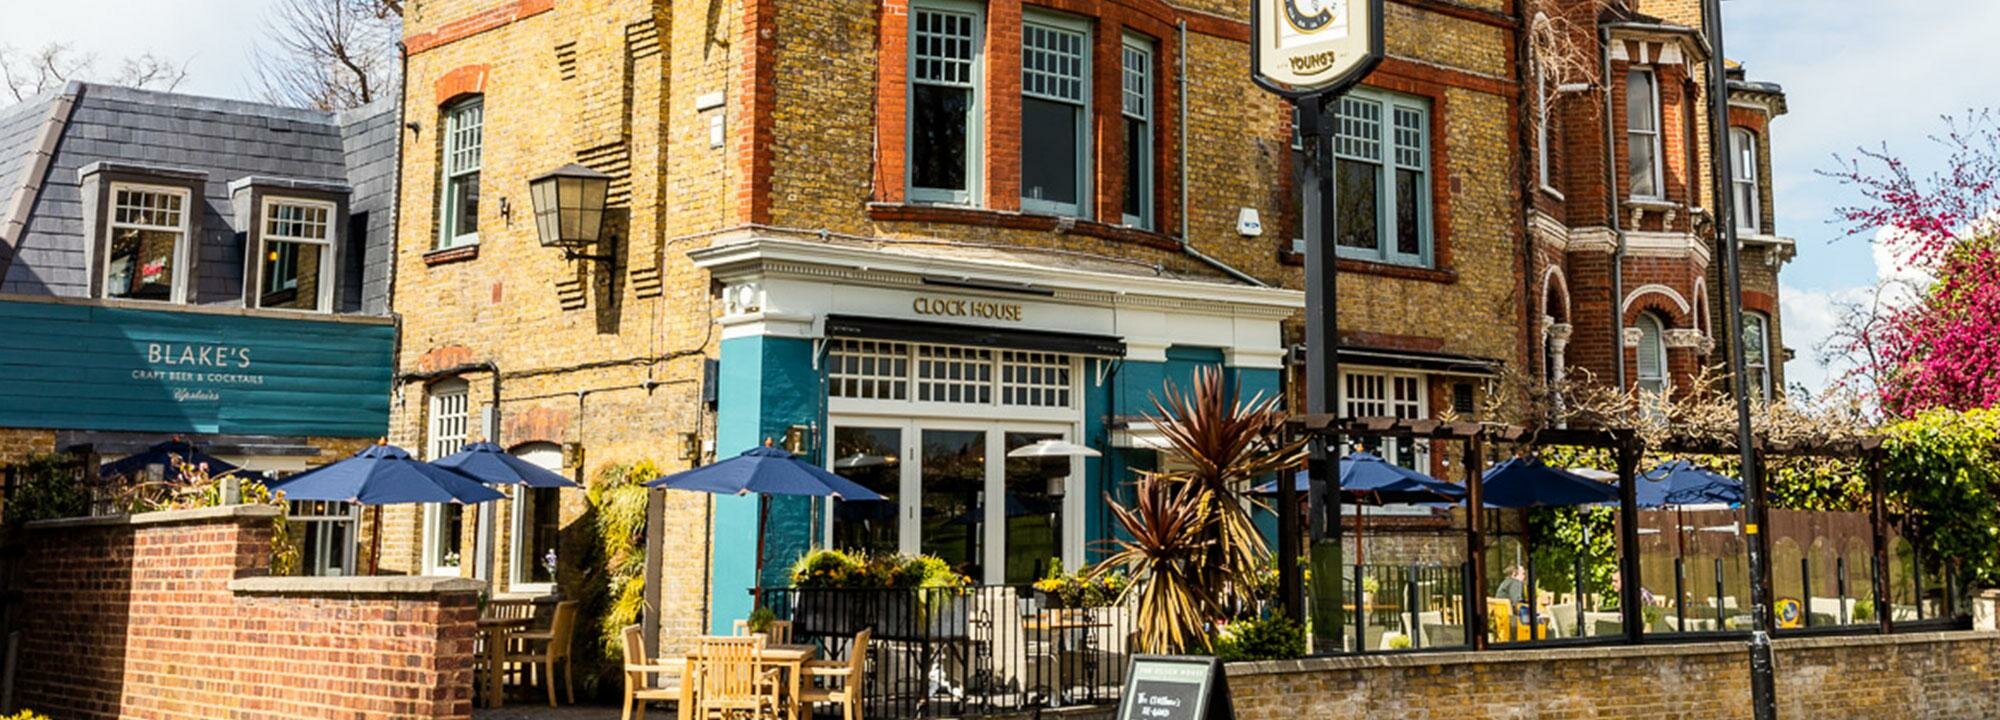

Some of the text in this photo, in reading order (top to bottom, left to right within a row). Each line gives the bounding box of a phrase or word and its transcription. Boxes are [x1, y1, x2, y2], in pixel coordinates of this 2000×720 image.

[1288, 51, 1335, 70] YOUNG'S
[912, 297, 1022, 321] CLOCK HOUSE
[148, 342, 251, 368] BLAKE'S
[131, 370, 264, 384] CRAFT BEER & COCKTAILS
